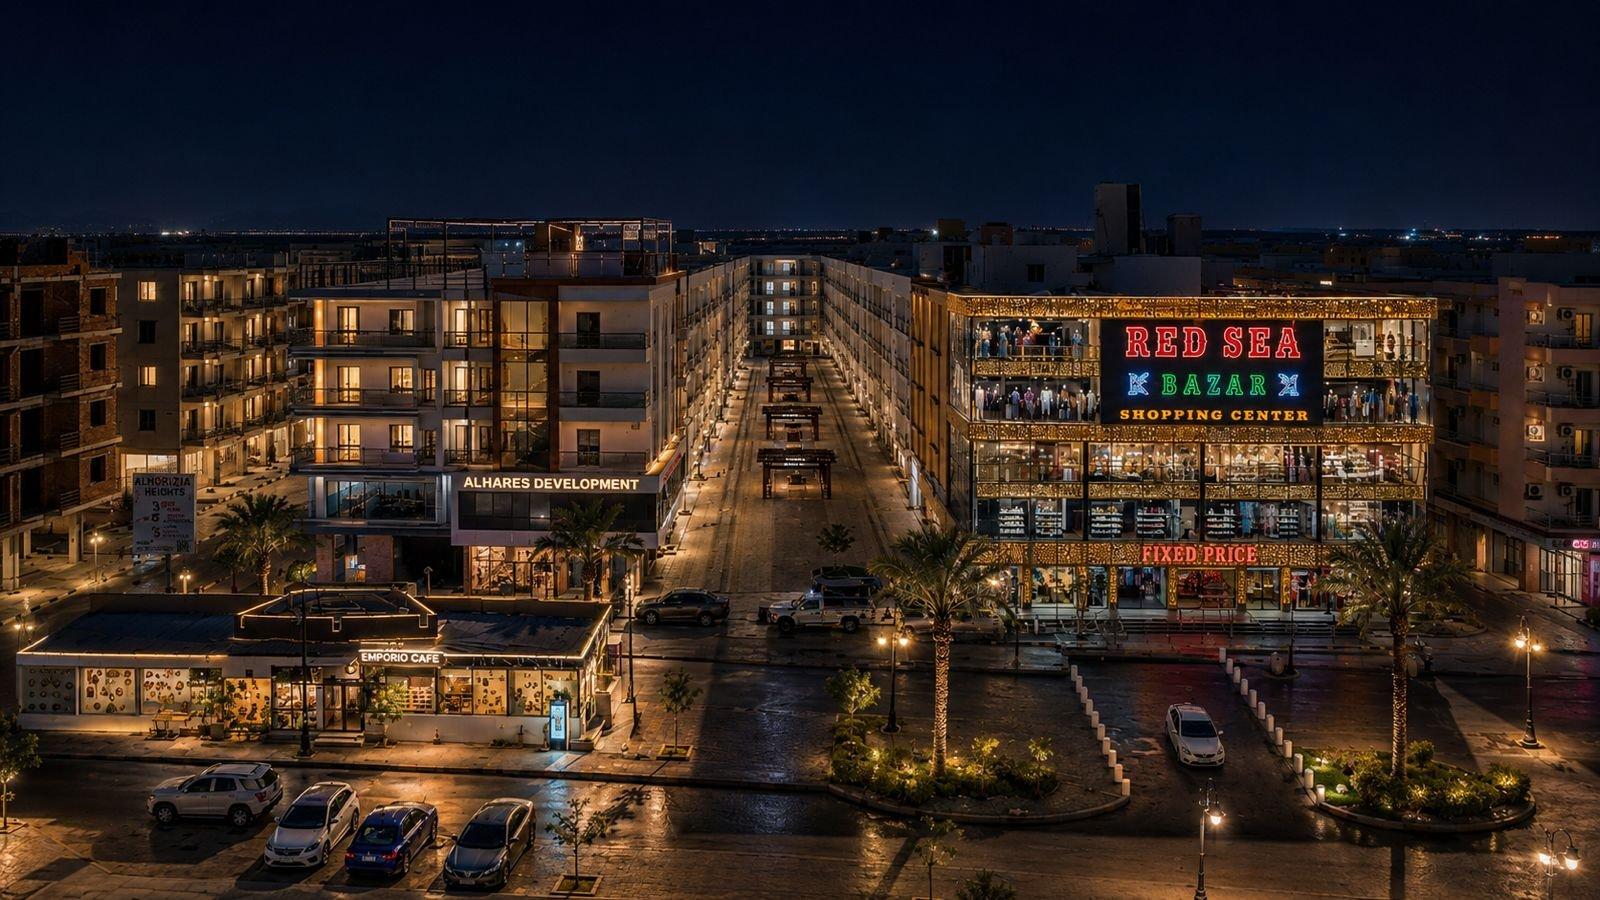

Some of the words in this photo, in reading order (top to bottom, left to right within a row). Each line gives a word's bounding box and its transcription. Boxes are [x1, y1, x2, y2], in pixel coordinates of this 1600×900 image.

[1126, 326, 1208, 357] RED
[1223, 326, 1301, 358] SEA
[1162, 373, 1266, 396] BAZAR
[1120, 409, 1223, 421] SHOPPING
[1230, 409, 1308, 421] CENTER
[463, 476, 531, 489] ALHARES
[534, 478, 640, 491] DEVELOPMENT
[1142, 545, 1197, 562] FIXED
[1203, 545, 1257, 562] PRICE
[361, 652, 408, 663] EMPORIO
[410, 653, 440, 664] CAFE
